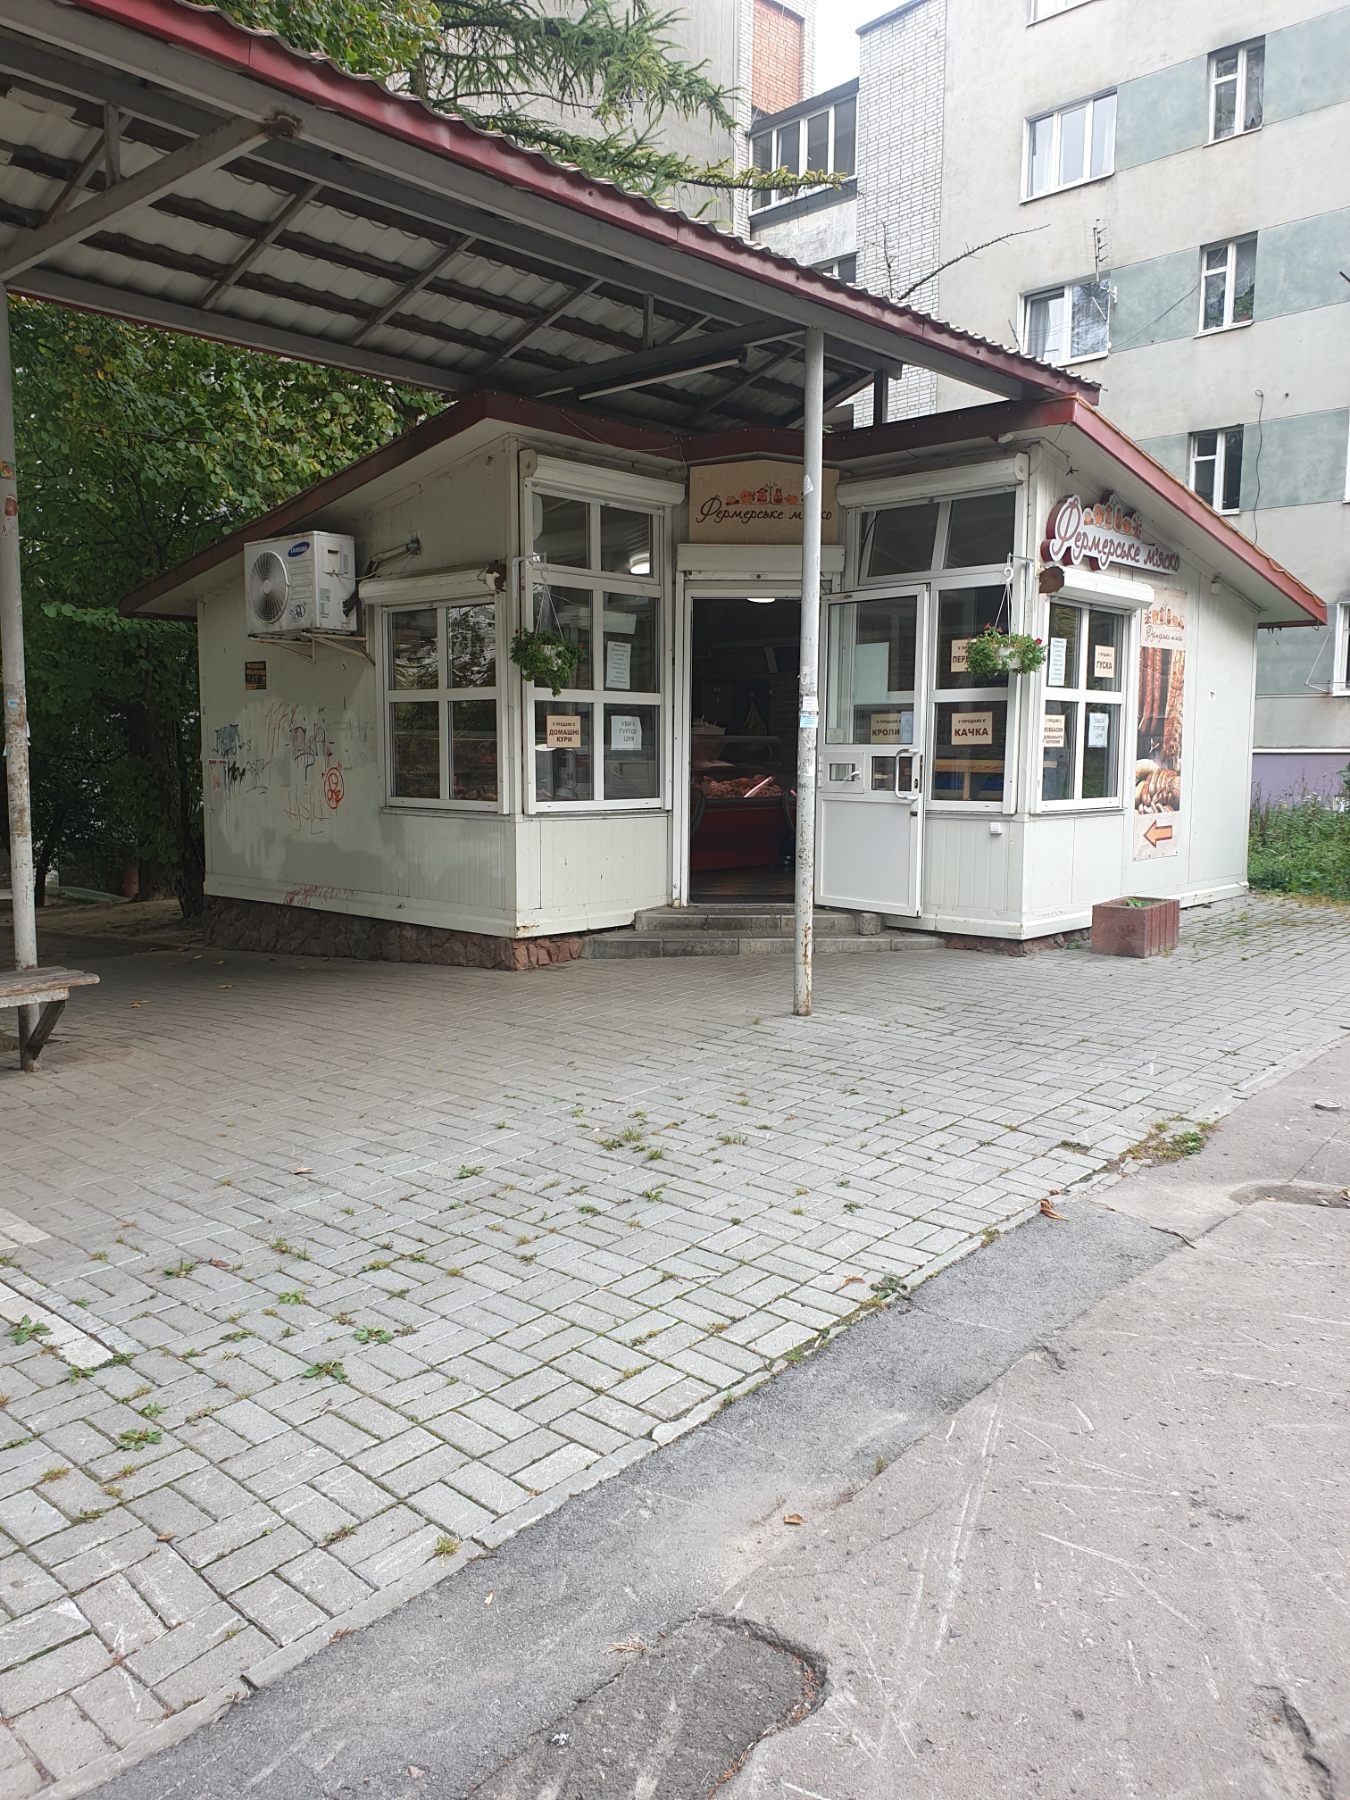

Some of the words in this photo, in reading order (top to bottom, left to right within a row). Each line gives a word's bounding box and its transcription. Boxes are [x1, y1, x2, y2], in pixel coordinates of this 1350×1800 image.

[696, 495, 784, 524] Фермерське
[1052, 499, 1141, 567] Фермерське
[549, 729, 580, 737] ДОМАШНІ
[871, 729, 901, 737] КРОЛИ
[954, 727, 989, 737] КАЧКА
